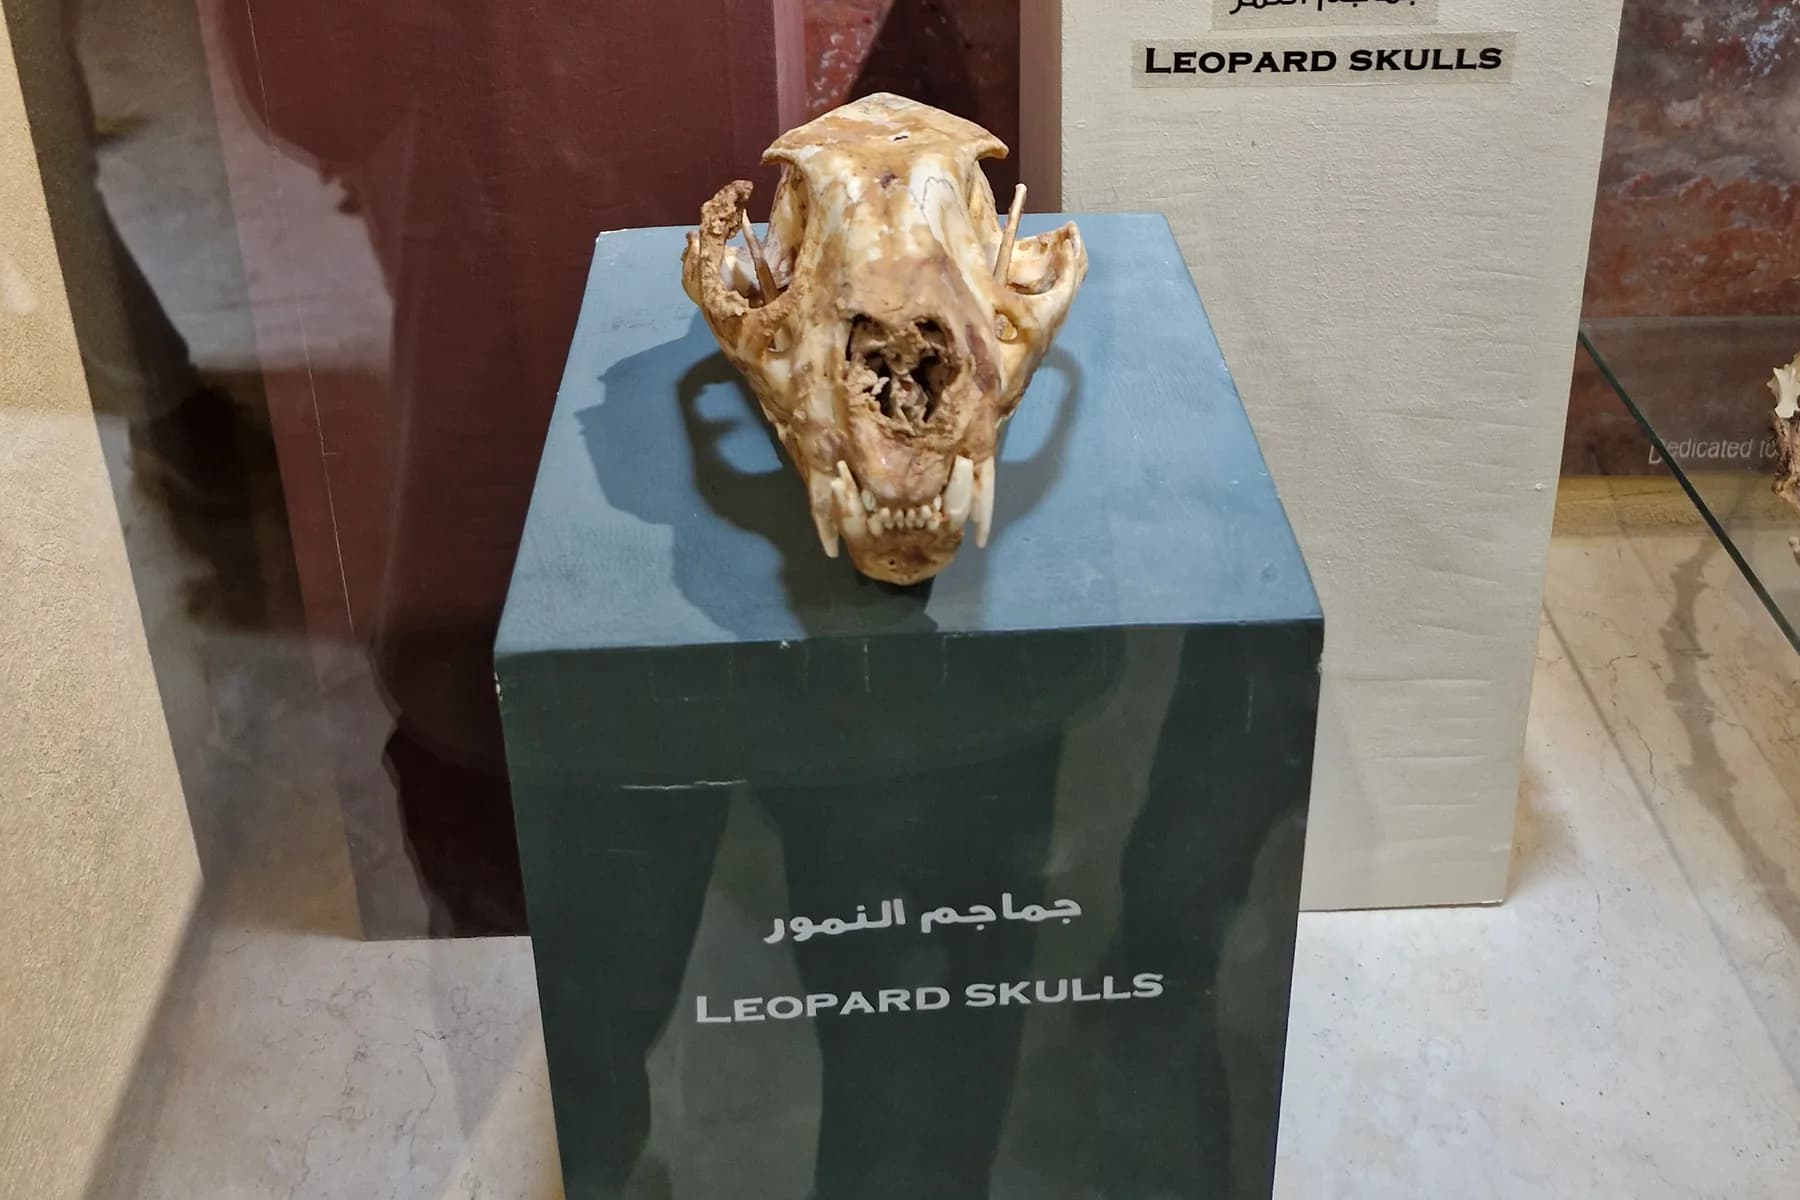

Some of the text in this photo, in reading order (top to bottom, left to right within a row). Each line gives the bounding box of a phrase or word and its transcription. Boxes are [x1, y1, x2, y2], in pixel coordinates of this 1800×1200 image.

[1145, 48, 1502, 74] LEOPARD SKULLS
[1649, 438, 1752, 464] Dedicated
[764, 893, 1081, 943] جماجم النمور
[697, 973, 1163, 1022] LEOPARD SKULLS
